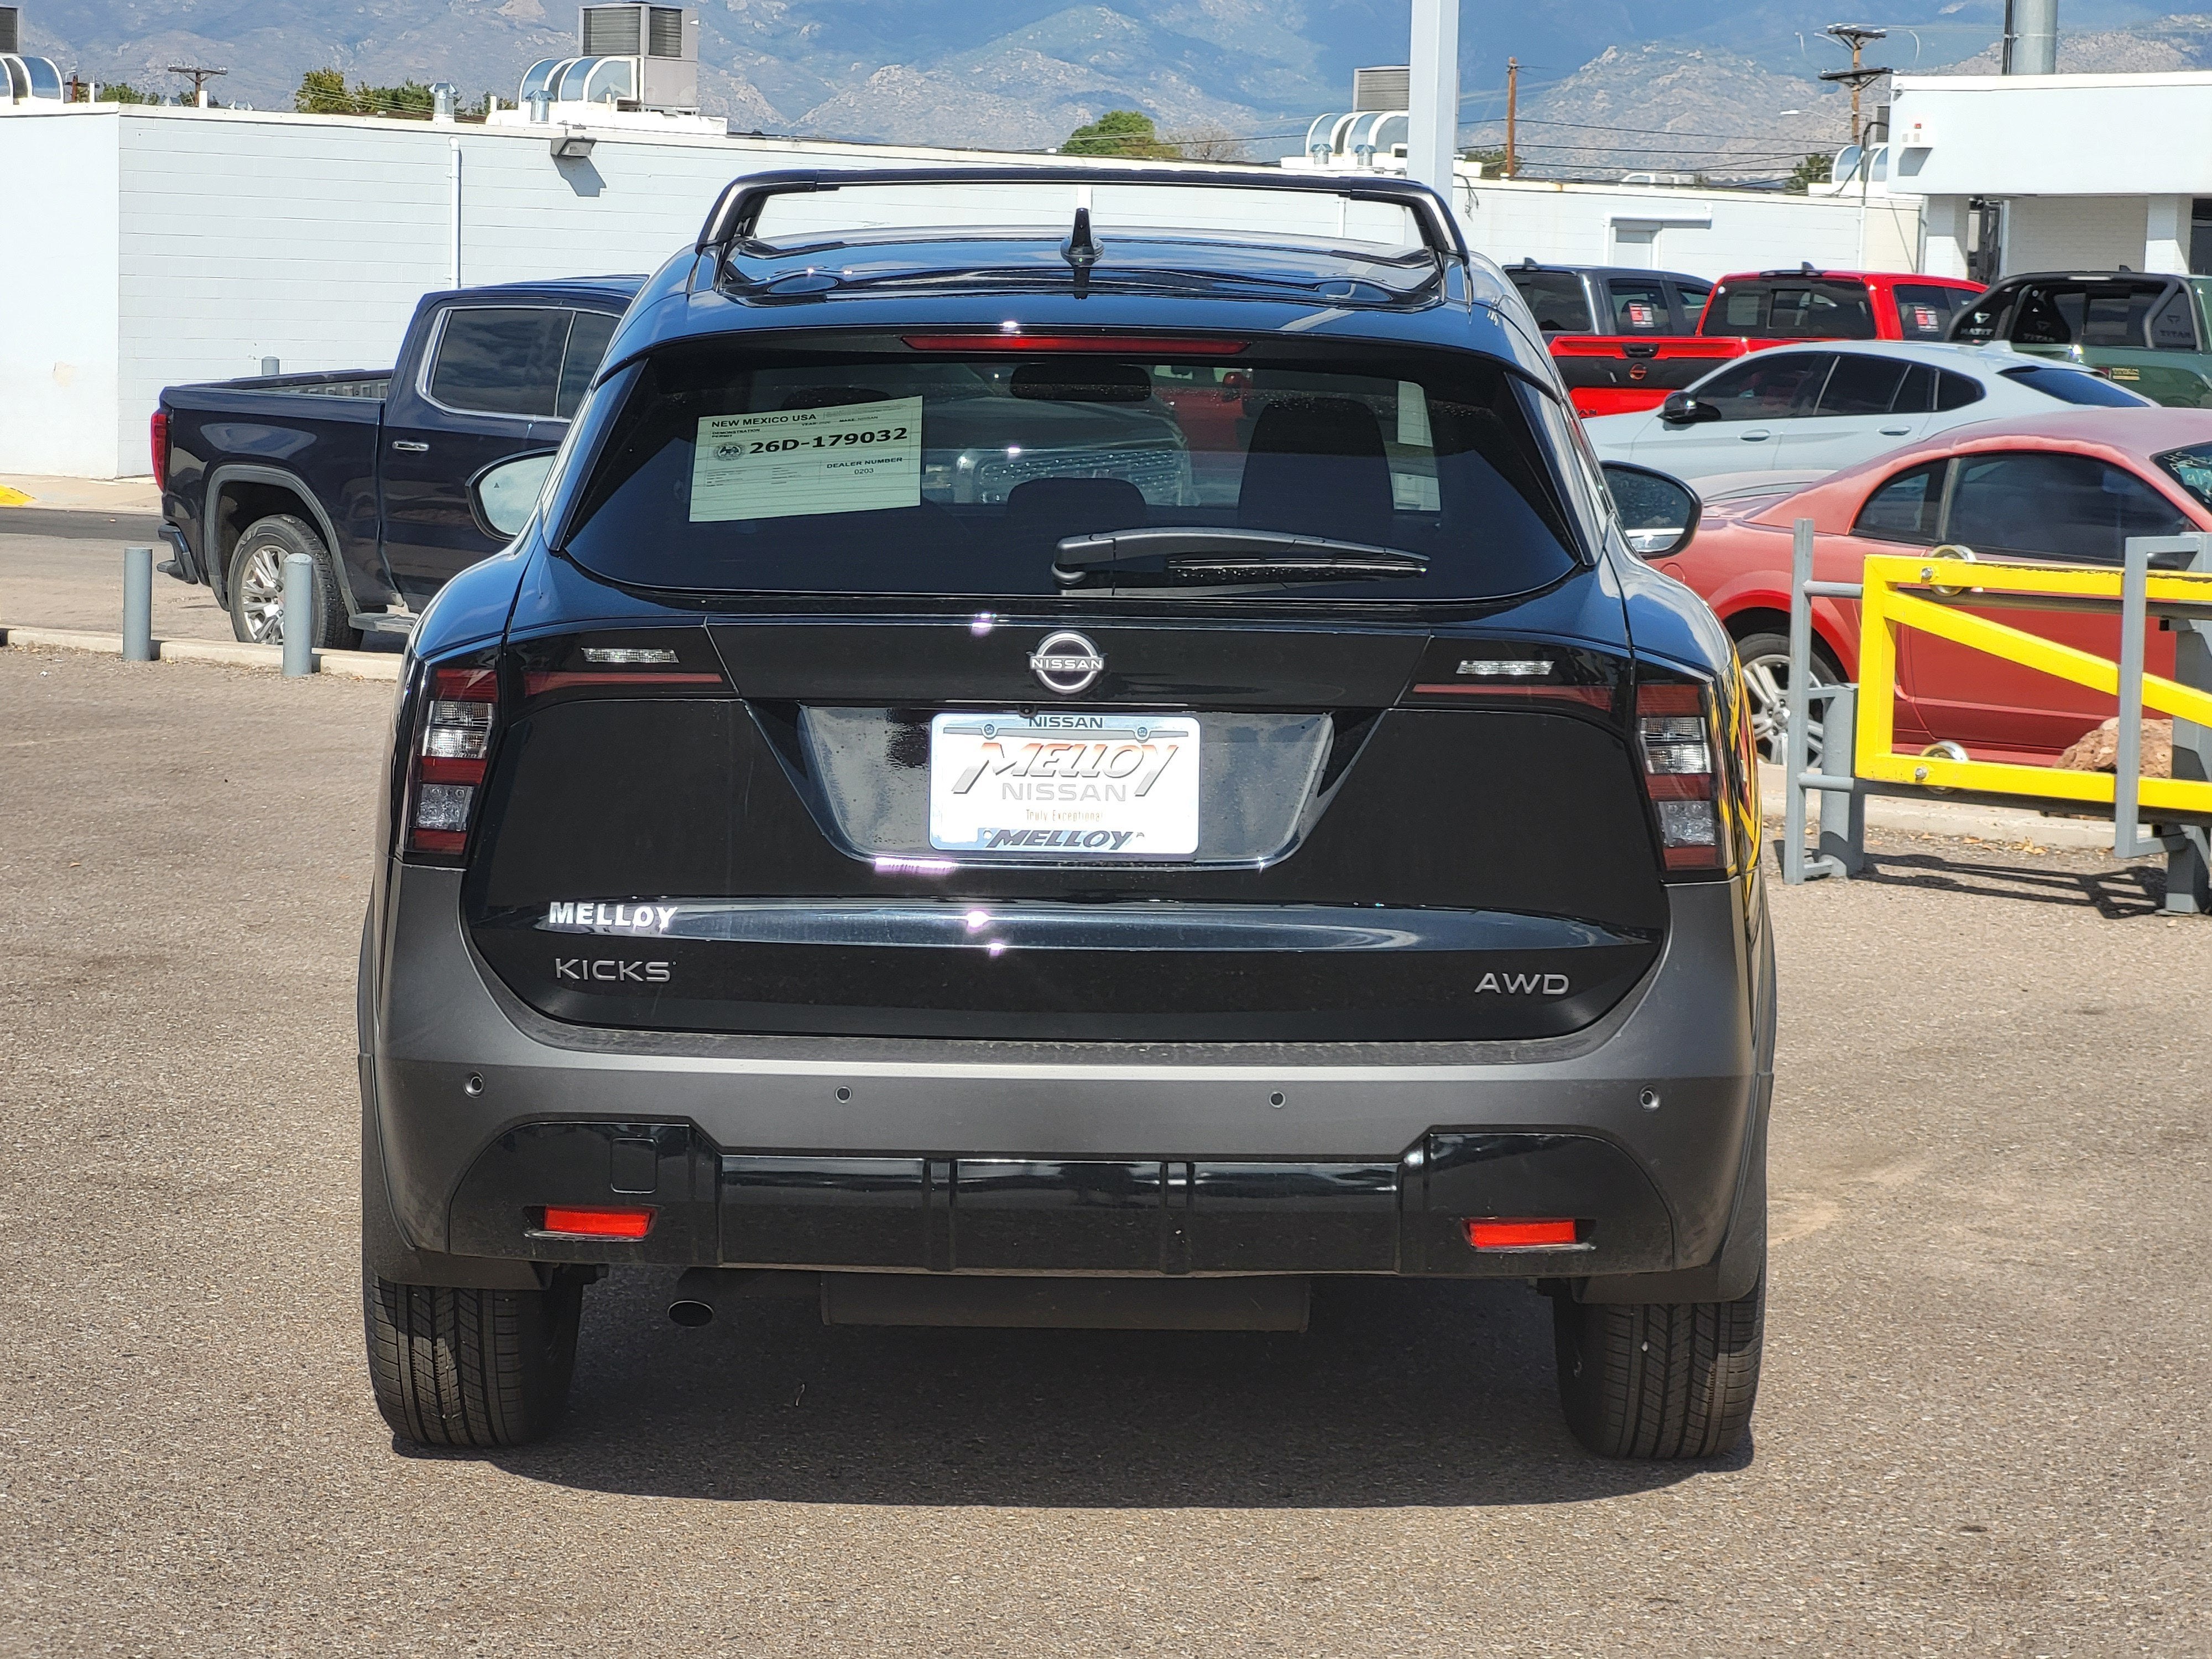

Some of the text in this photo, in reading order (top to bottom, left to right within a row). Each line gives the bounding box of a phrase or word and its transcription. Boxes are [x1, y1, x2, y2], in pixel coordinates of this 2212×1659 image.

[743, 416, 789, 426] MEXICO
[749, 427, 908, 454] 26D-179032
[1032, 659, 1102, 669] NISSAN
[1029, 717, 1103, 728] NISSAN
[951, 742, 1179, 797] MELLOY
[1002, 782, 1126, 802] NISSAN
[1026, 809, 1103, 822] Truly Exceptional
[985, 829, 1133, 850] MELLOY
[549, 901, 678, 929] MELLOY
[555, 958, 671, 982] KICKS
[1474, 972, 1569, 995] AWD
